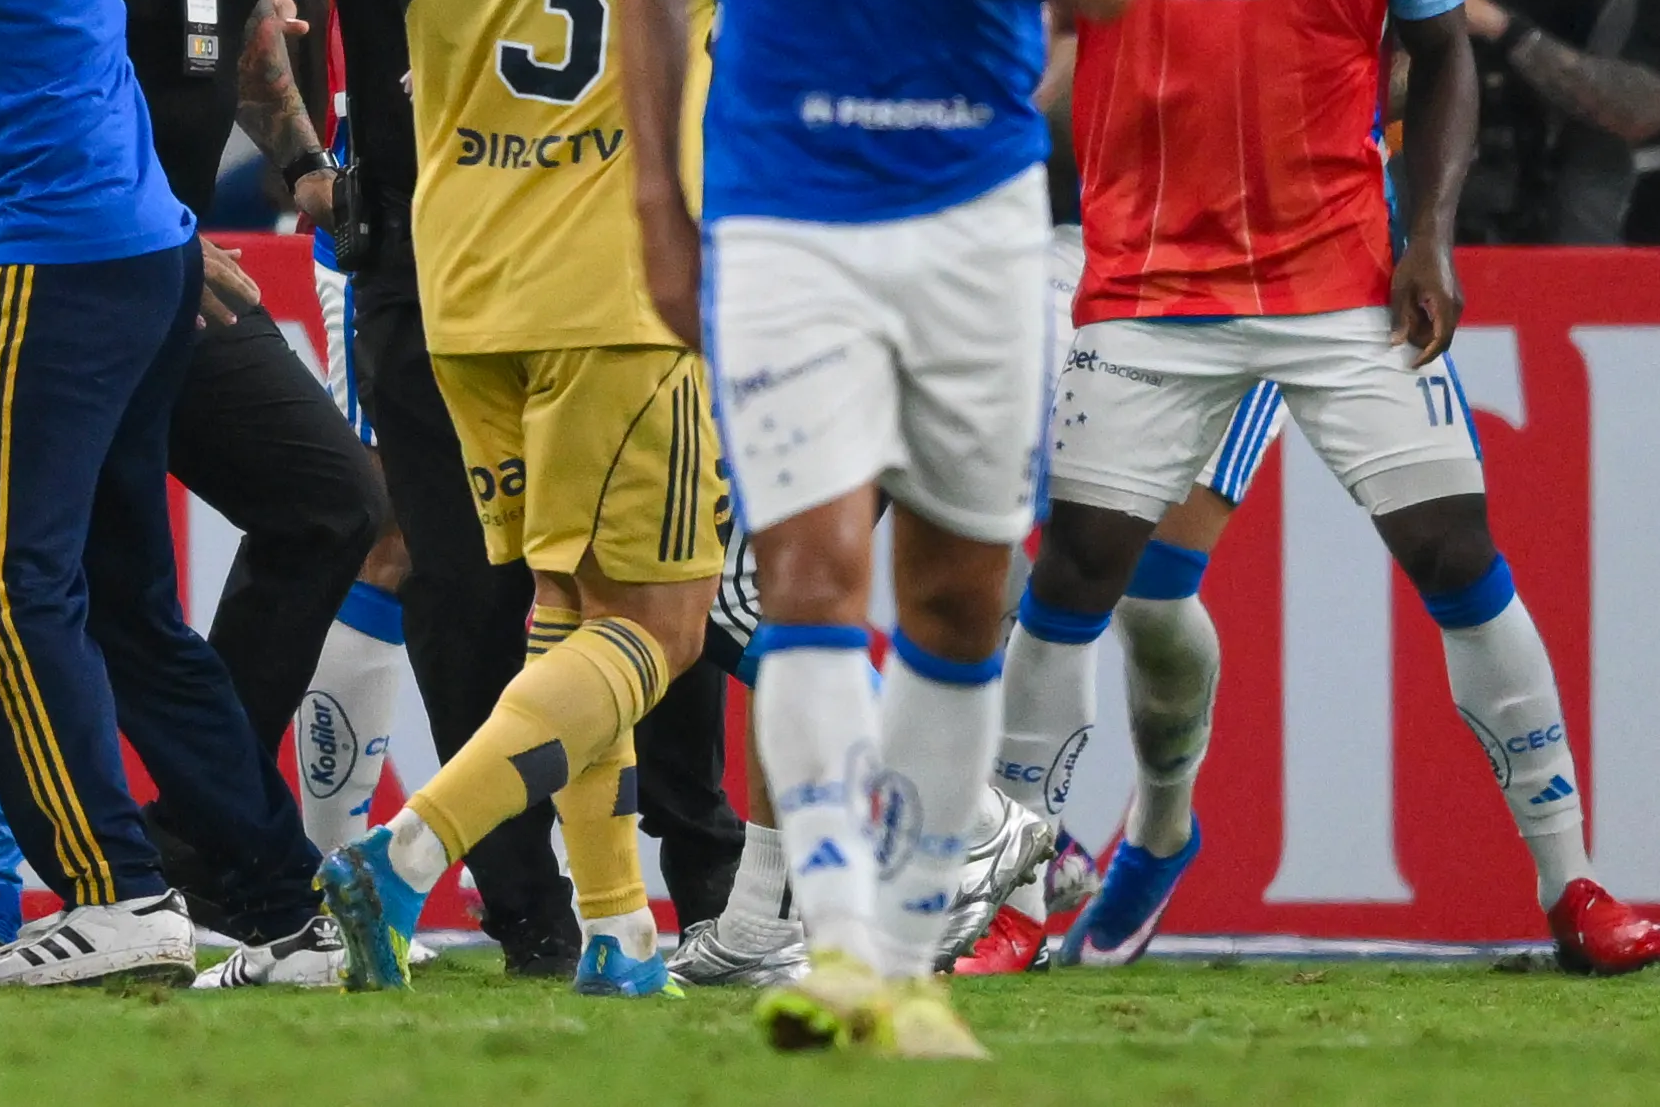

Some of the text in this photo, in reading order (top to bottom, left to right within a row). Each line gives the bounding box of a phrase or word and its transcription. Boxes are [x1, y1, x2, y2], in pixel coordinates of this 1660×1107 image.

[1098, 361, 1163, 387] nacional
[1416, 376, 1453, 426] 17
[469, 458, 527, 503] pa
[310, 698, 337, 786] Kodilar
[1506, 723, 1563, 753] CEC
